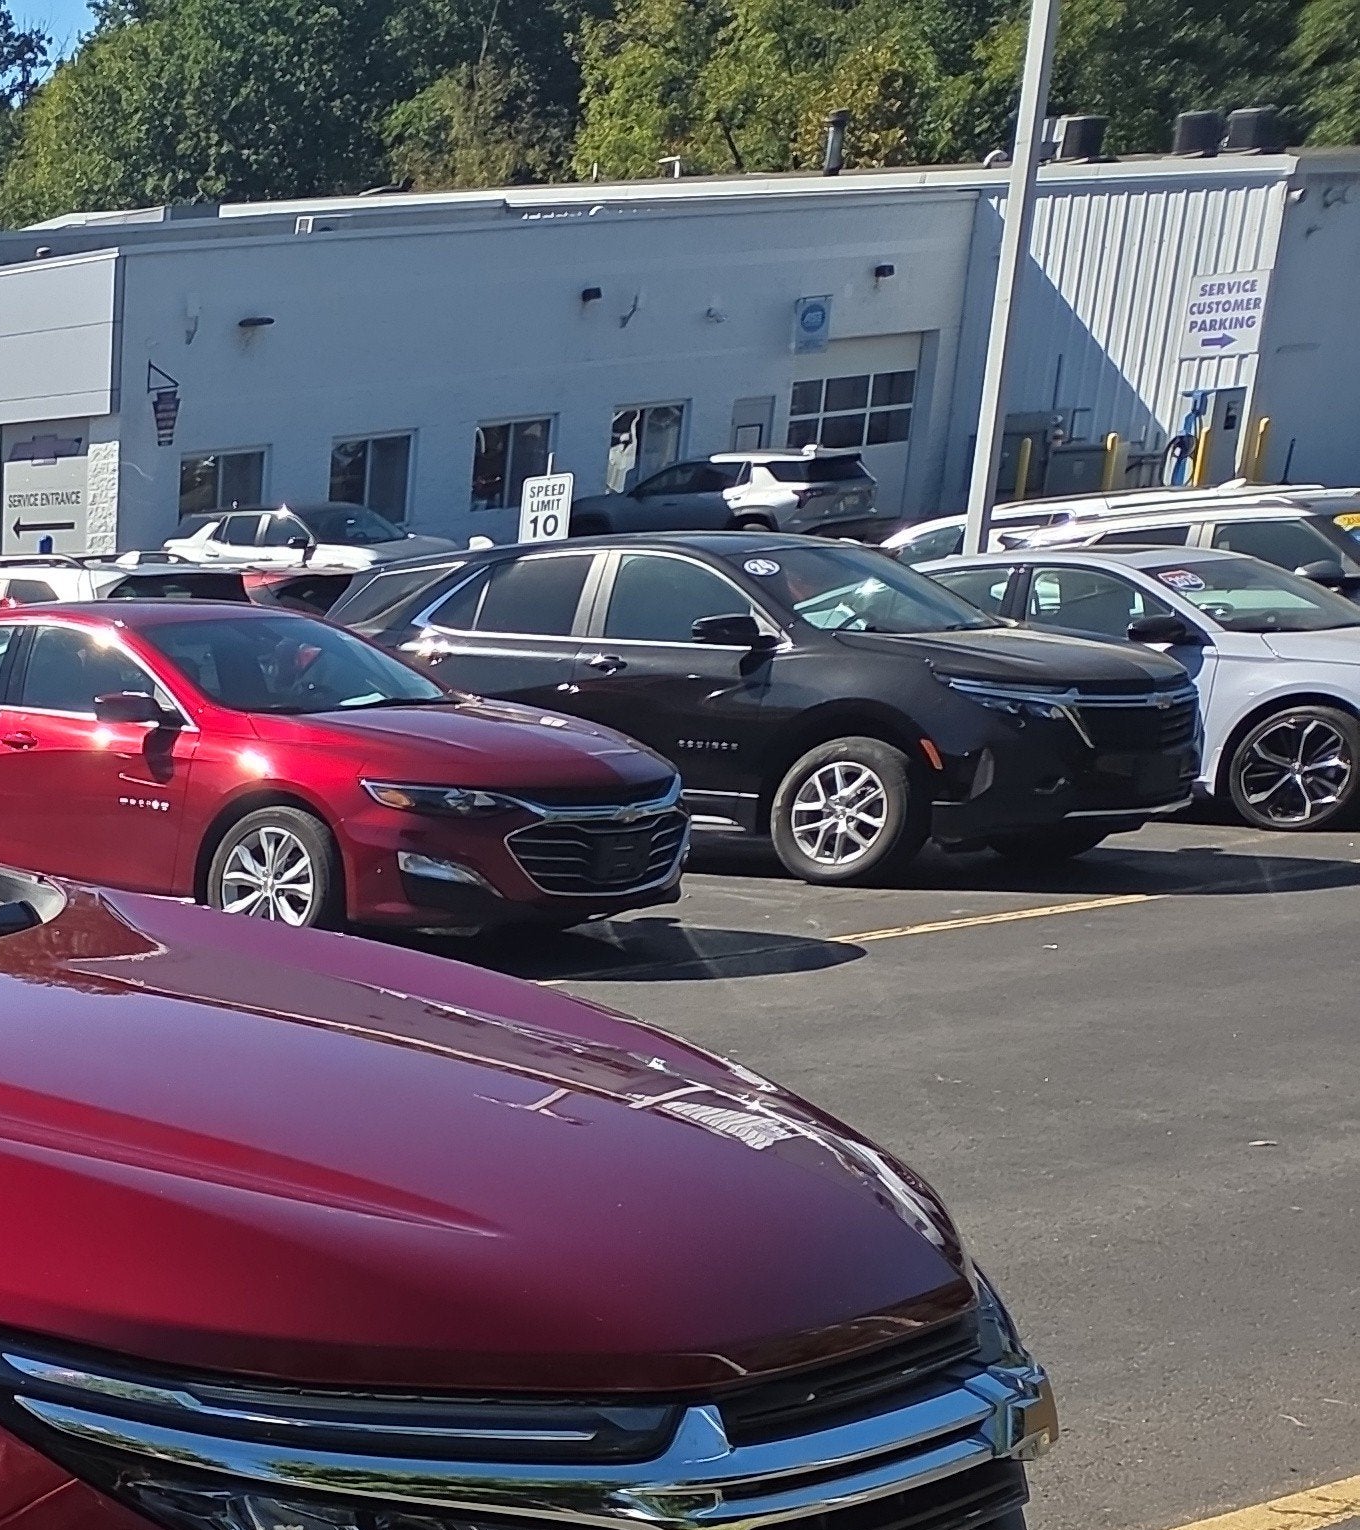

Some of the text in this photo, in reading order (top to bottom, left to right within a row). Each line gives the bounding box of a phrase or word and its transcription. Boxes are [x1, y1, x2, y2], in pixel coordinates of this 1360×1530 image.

[1199, 280, 1258, 297] SERVICE
[1189, 297, 1262, 315] CUSTOMER
[1189, 316, 1256, 333] PARKING
[529, 483, 566, 498] SPEED
[8, 491, 81, 508] SERVICE ENTRANCE
[530, 499, 562, 513] LIMIT
[529, 514, 559, 539] 10
